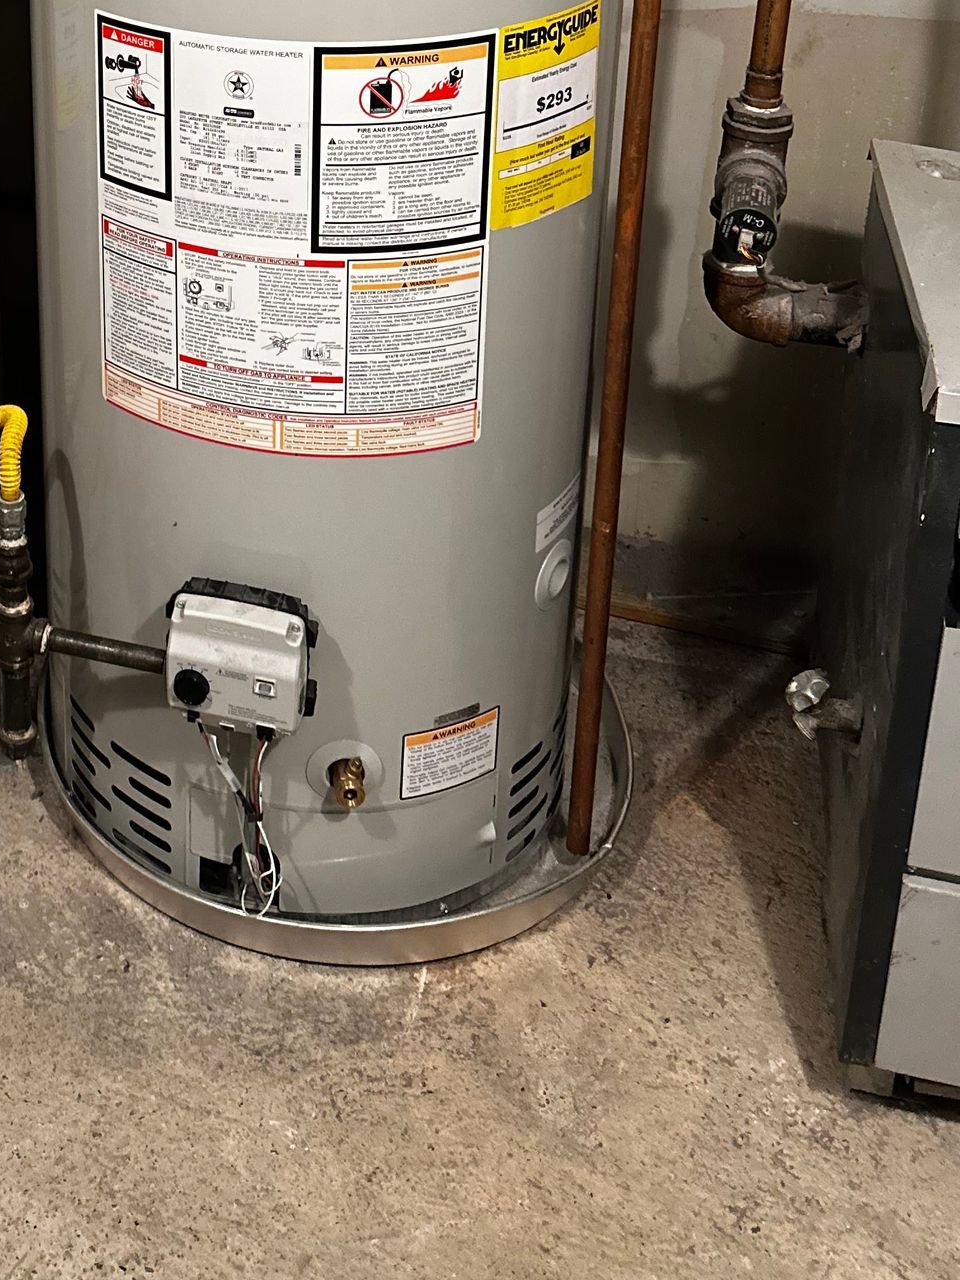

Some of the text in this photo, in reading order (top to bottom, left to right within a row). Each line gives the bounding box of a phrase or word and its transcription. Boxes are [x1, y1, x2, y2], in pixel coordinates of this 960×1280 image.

[504, 4, 598, 54] ENERGYGUIDE
[121, 34, 155, 49] DANGER
[179, 41, 214, 51] AUTOMATIC
[217, 46, 248, 54] STORAGE
[390, 54, 439, 65] WARNING
[537, 87, 572, 113] $293
[121, 234, 138, 244] BEFORE
[139, 241, 165, 252] OPERATING
[139, 236, 156, 244] SAFETY
[223, 252, 299, 266] OPERATING INSTRUCTIONS
[439, 721, 476, 738] WARNING
